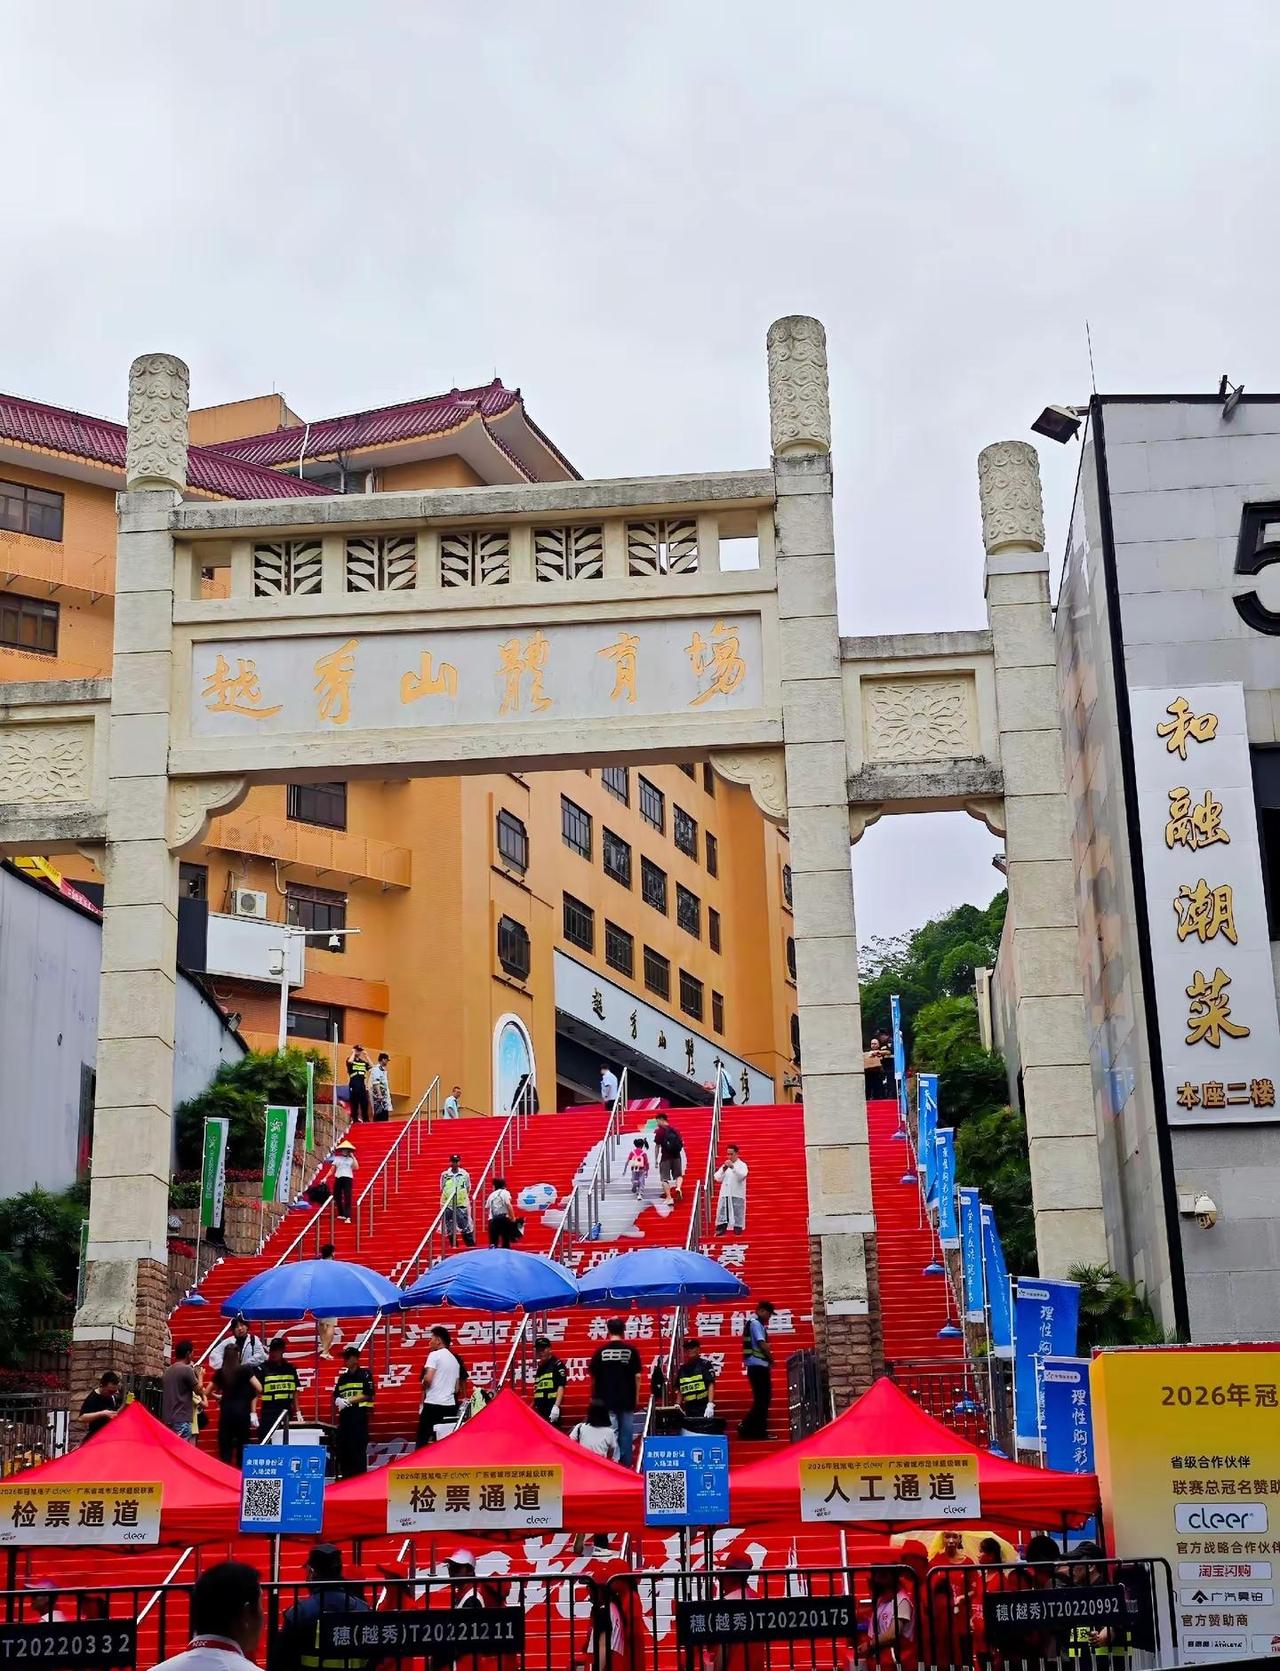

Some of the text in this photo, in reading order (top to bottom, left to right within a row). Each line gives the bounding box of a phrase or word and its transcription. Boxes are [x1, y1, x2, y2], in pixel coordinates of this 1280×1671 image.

[201, 617, 747, 724] 越秀山體育場
[1157, 696, 1250, 1050] 和融潮菜
[1177, 1079, 1275, 1110] 本座二楼
[1171, 1455, 1251, 1469] 省级合作伙伴
[409, 1483, 541, 1513] 检票通道
[824, 1472, 956, 1503] 人工通道
[11, 1500, 139, 1528] 检票通道
[1188, 1507, 1249, 1529] cleer
[1199, 1564, 1251, 1577] 淘宝闪购
[690, 1609, 849, 1633] 穗(越秀)T20220175
[996, 1598, 1119, 1621] 穗(越秀)T20220992
[1181, 1614, 1248, 1627] 官方赞助商
[2, 1634, 130, 1657] T20220332
[333, 1622, 514, 1646] 穗(越秀)T20221211
